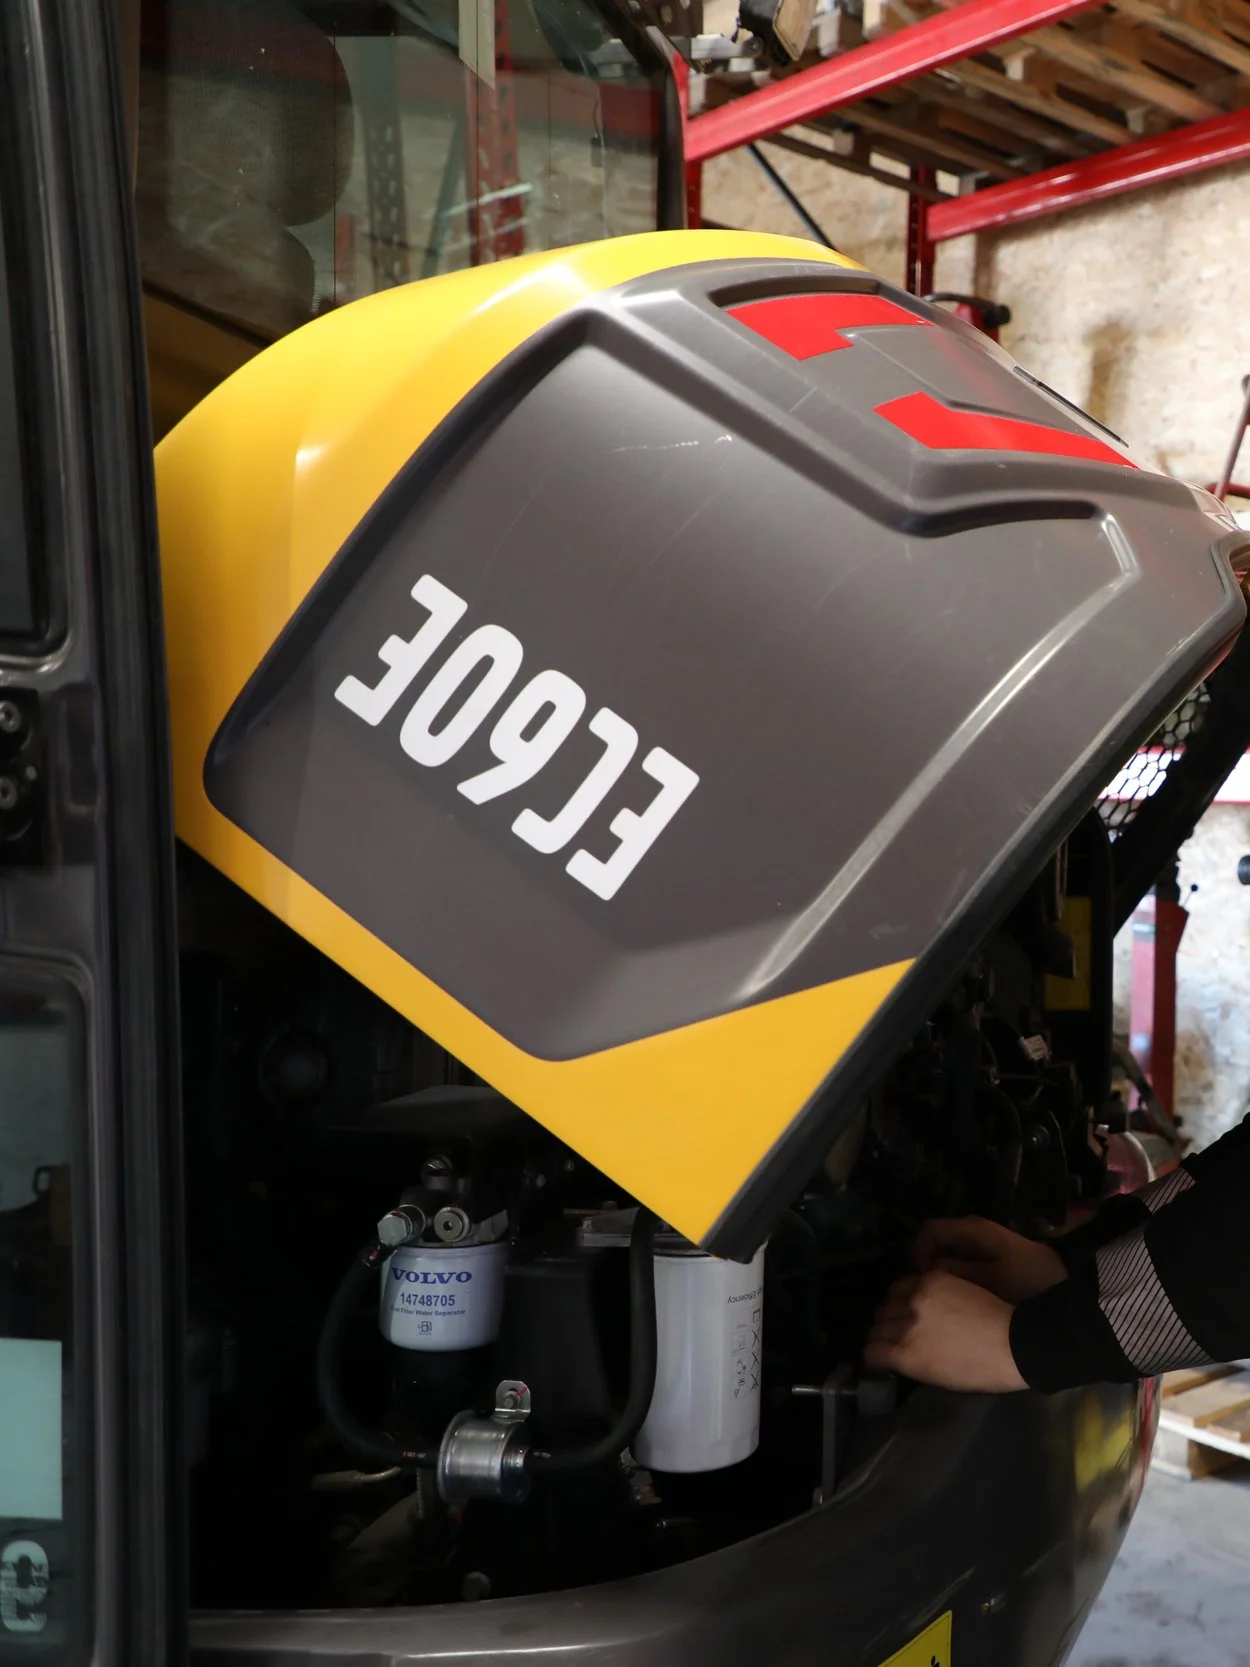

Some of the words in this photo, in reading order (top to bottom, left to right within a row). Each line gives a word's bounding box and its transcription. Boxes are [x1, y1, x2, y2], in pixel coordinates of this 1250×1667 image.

[334, 574, 700, 901] EC60E
[391, 1267, 473, 1284] VOLVO
[400, 1292, 456, 1307] 14748705
[434, 1309, 466, 1317] Separator
